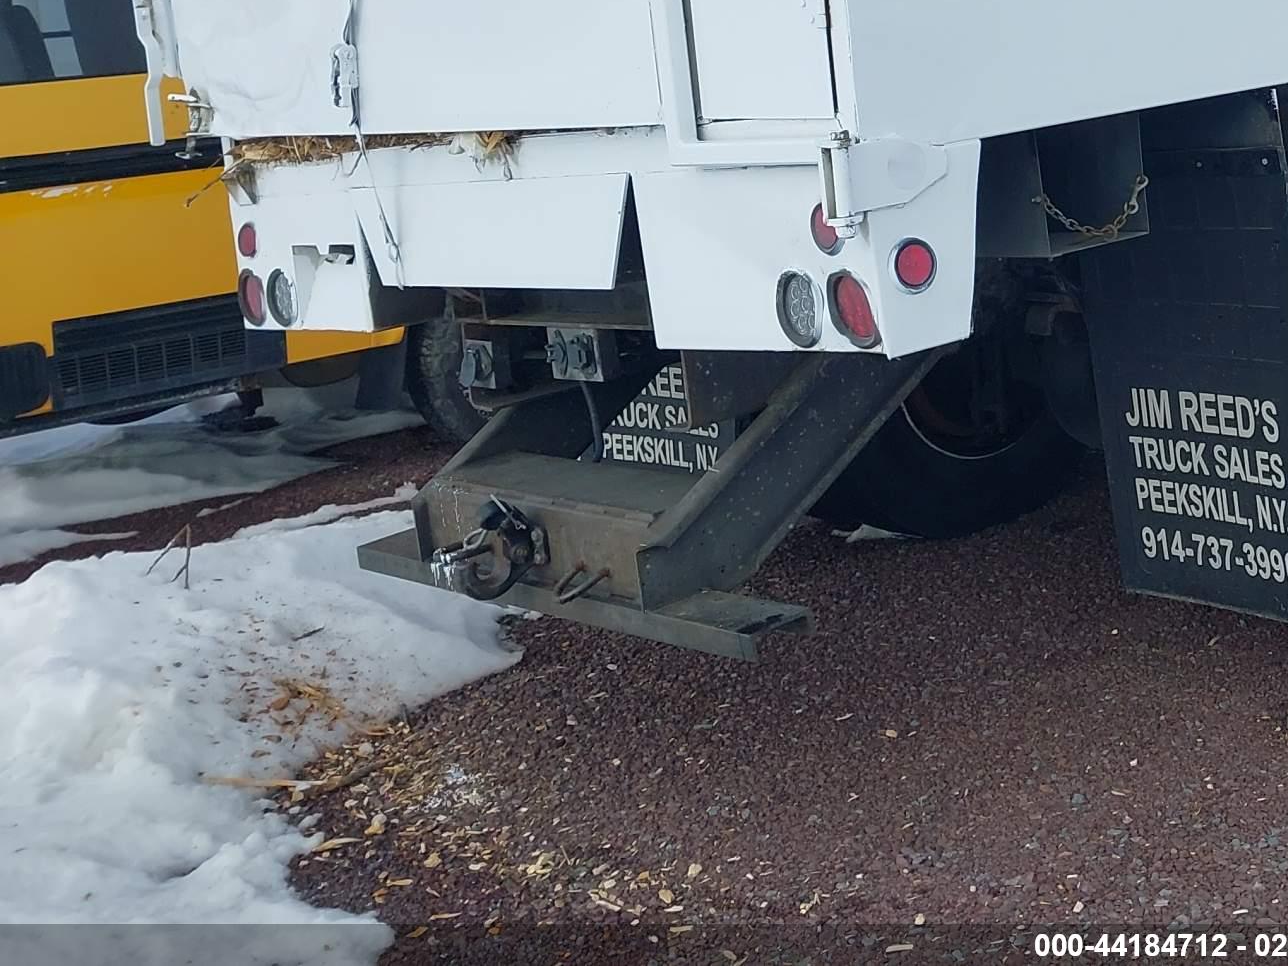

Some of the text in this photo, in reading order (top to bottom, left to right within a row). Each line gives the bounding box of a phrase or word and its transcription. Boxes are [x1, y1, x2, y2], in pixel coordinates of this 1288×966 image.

[611, 401, 661, 430] UCK
[1125, 387, 1280, 443] JIM REED'S
[601, 432, 693, 474] PEEKSKILL,
[1128, 435, 1286, 490] TRUCK SALES
[1135, 477, 1254, 533] PEEKSKILL,
